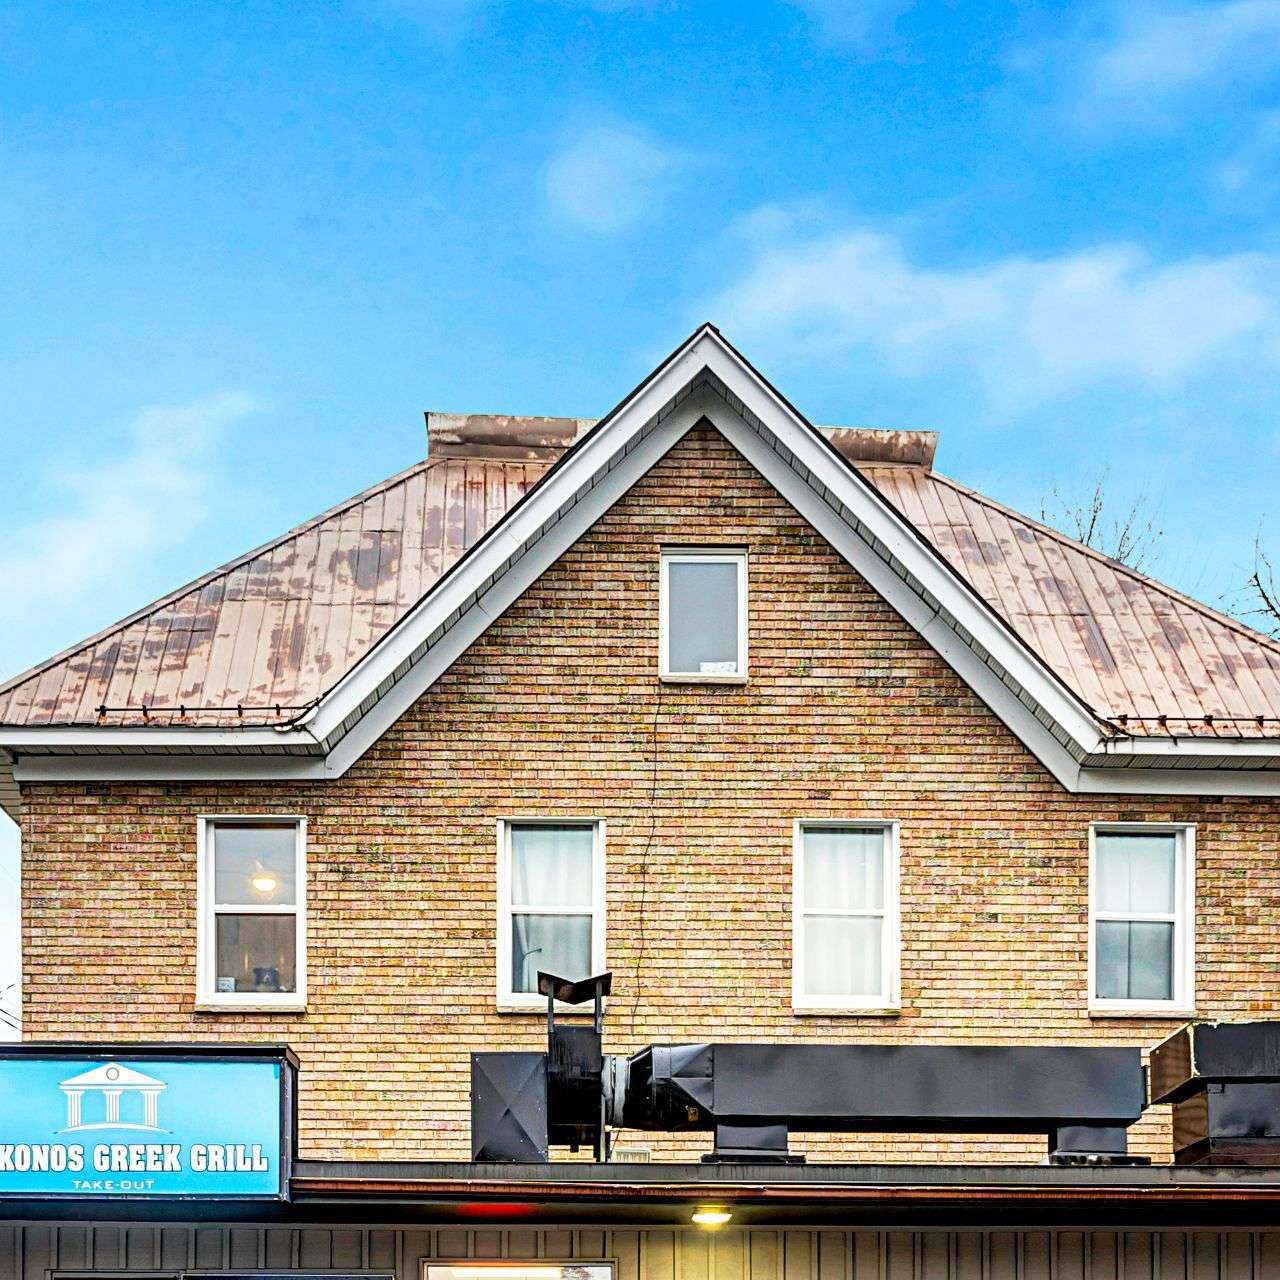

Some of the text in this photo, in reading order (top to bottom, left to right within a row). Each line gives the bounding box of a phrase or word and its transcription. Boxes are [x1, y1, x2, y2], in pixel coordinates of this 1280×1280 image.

[93, 1144, 182, 1173] GREEK
[190, 1144, 268, 1173] GRILL
[72, 1179, 155, 1189] TAKE-OUT
